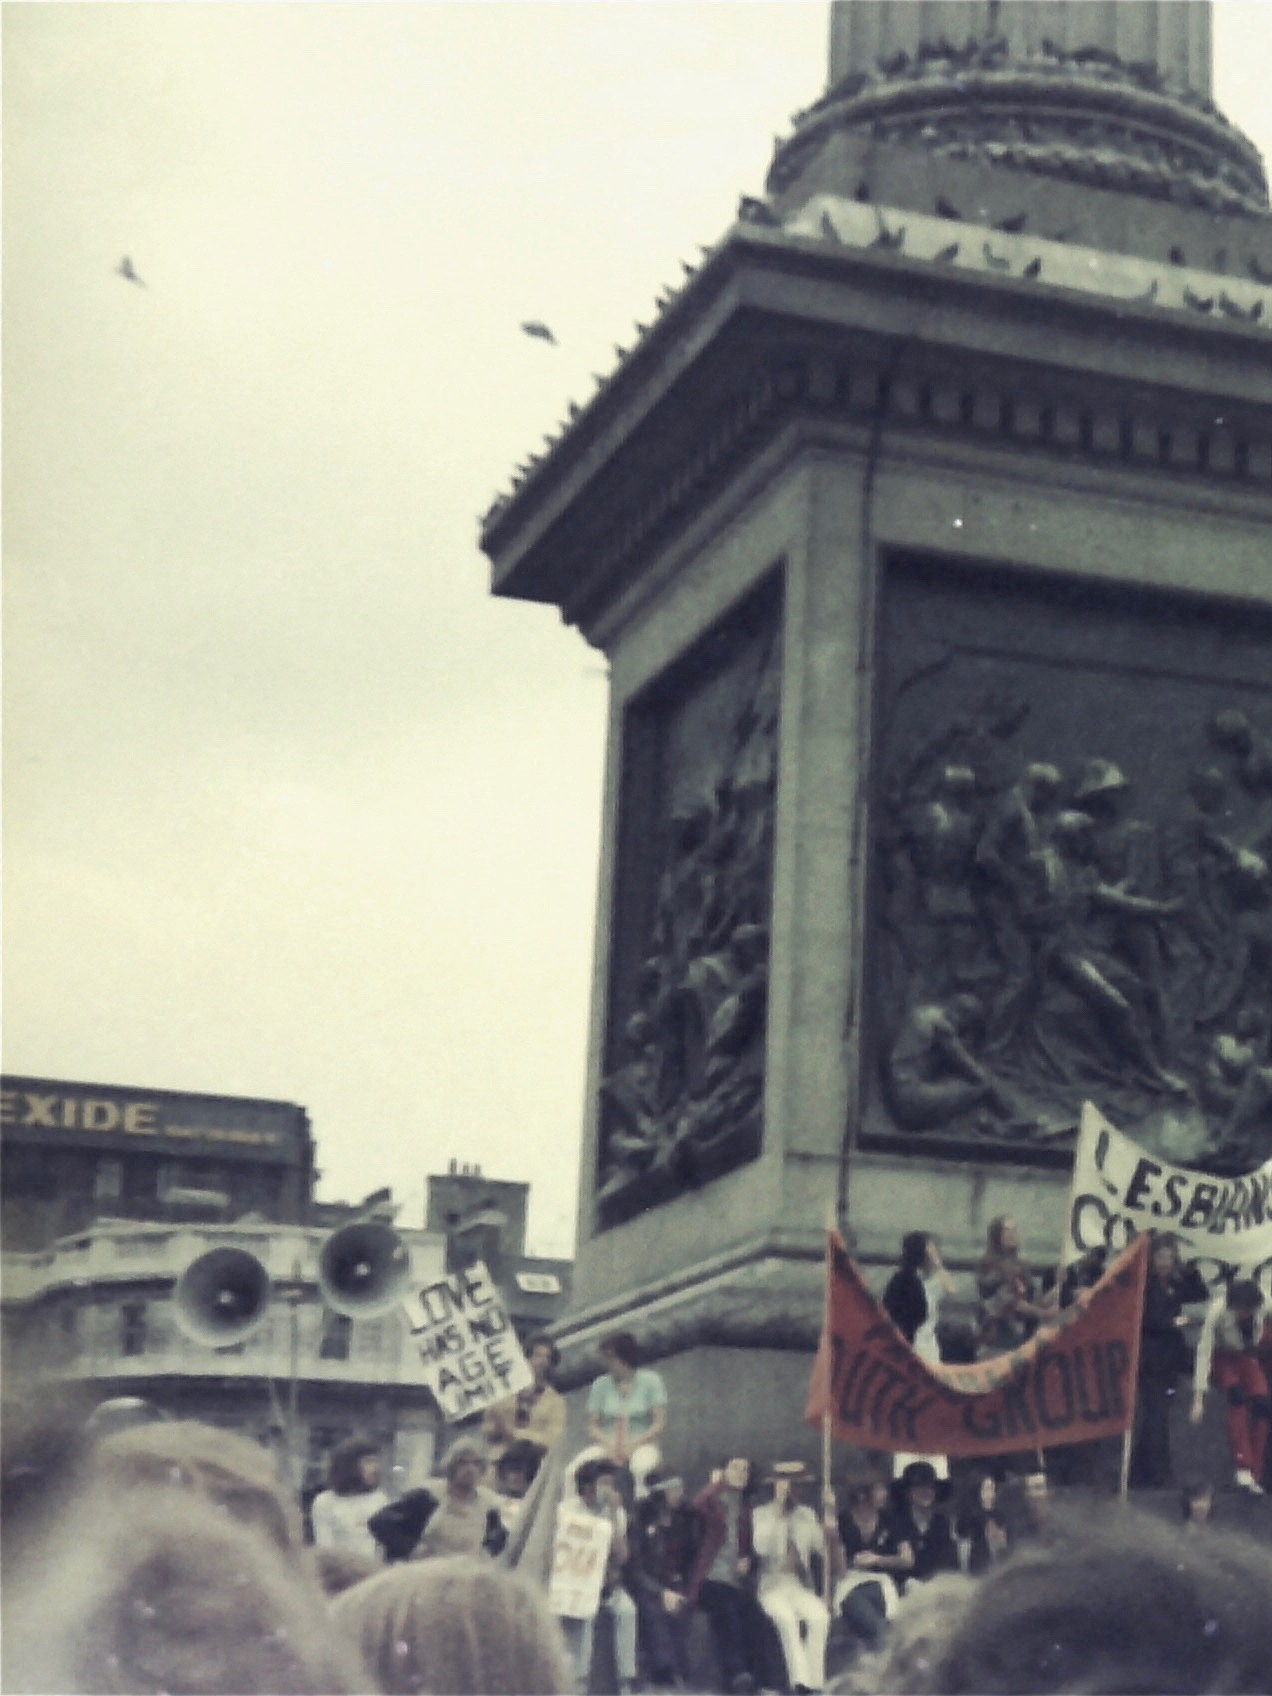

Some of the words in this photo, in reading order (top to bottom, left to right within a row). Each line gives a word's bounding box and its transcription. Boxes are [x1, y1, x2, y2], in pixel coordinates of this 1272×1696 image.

[0, 1090, 160, 1136] EXIDE
[410, 1273, 493, 1336] LOVE
[961, 1340, 1132, 1438] GROUP
